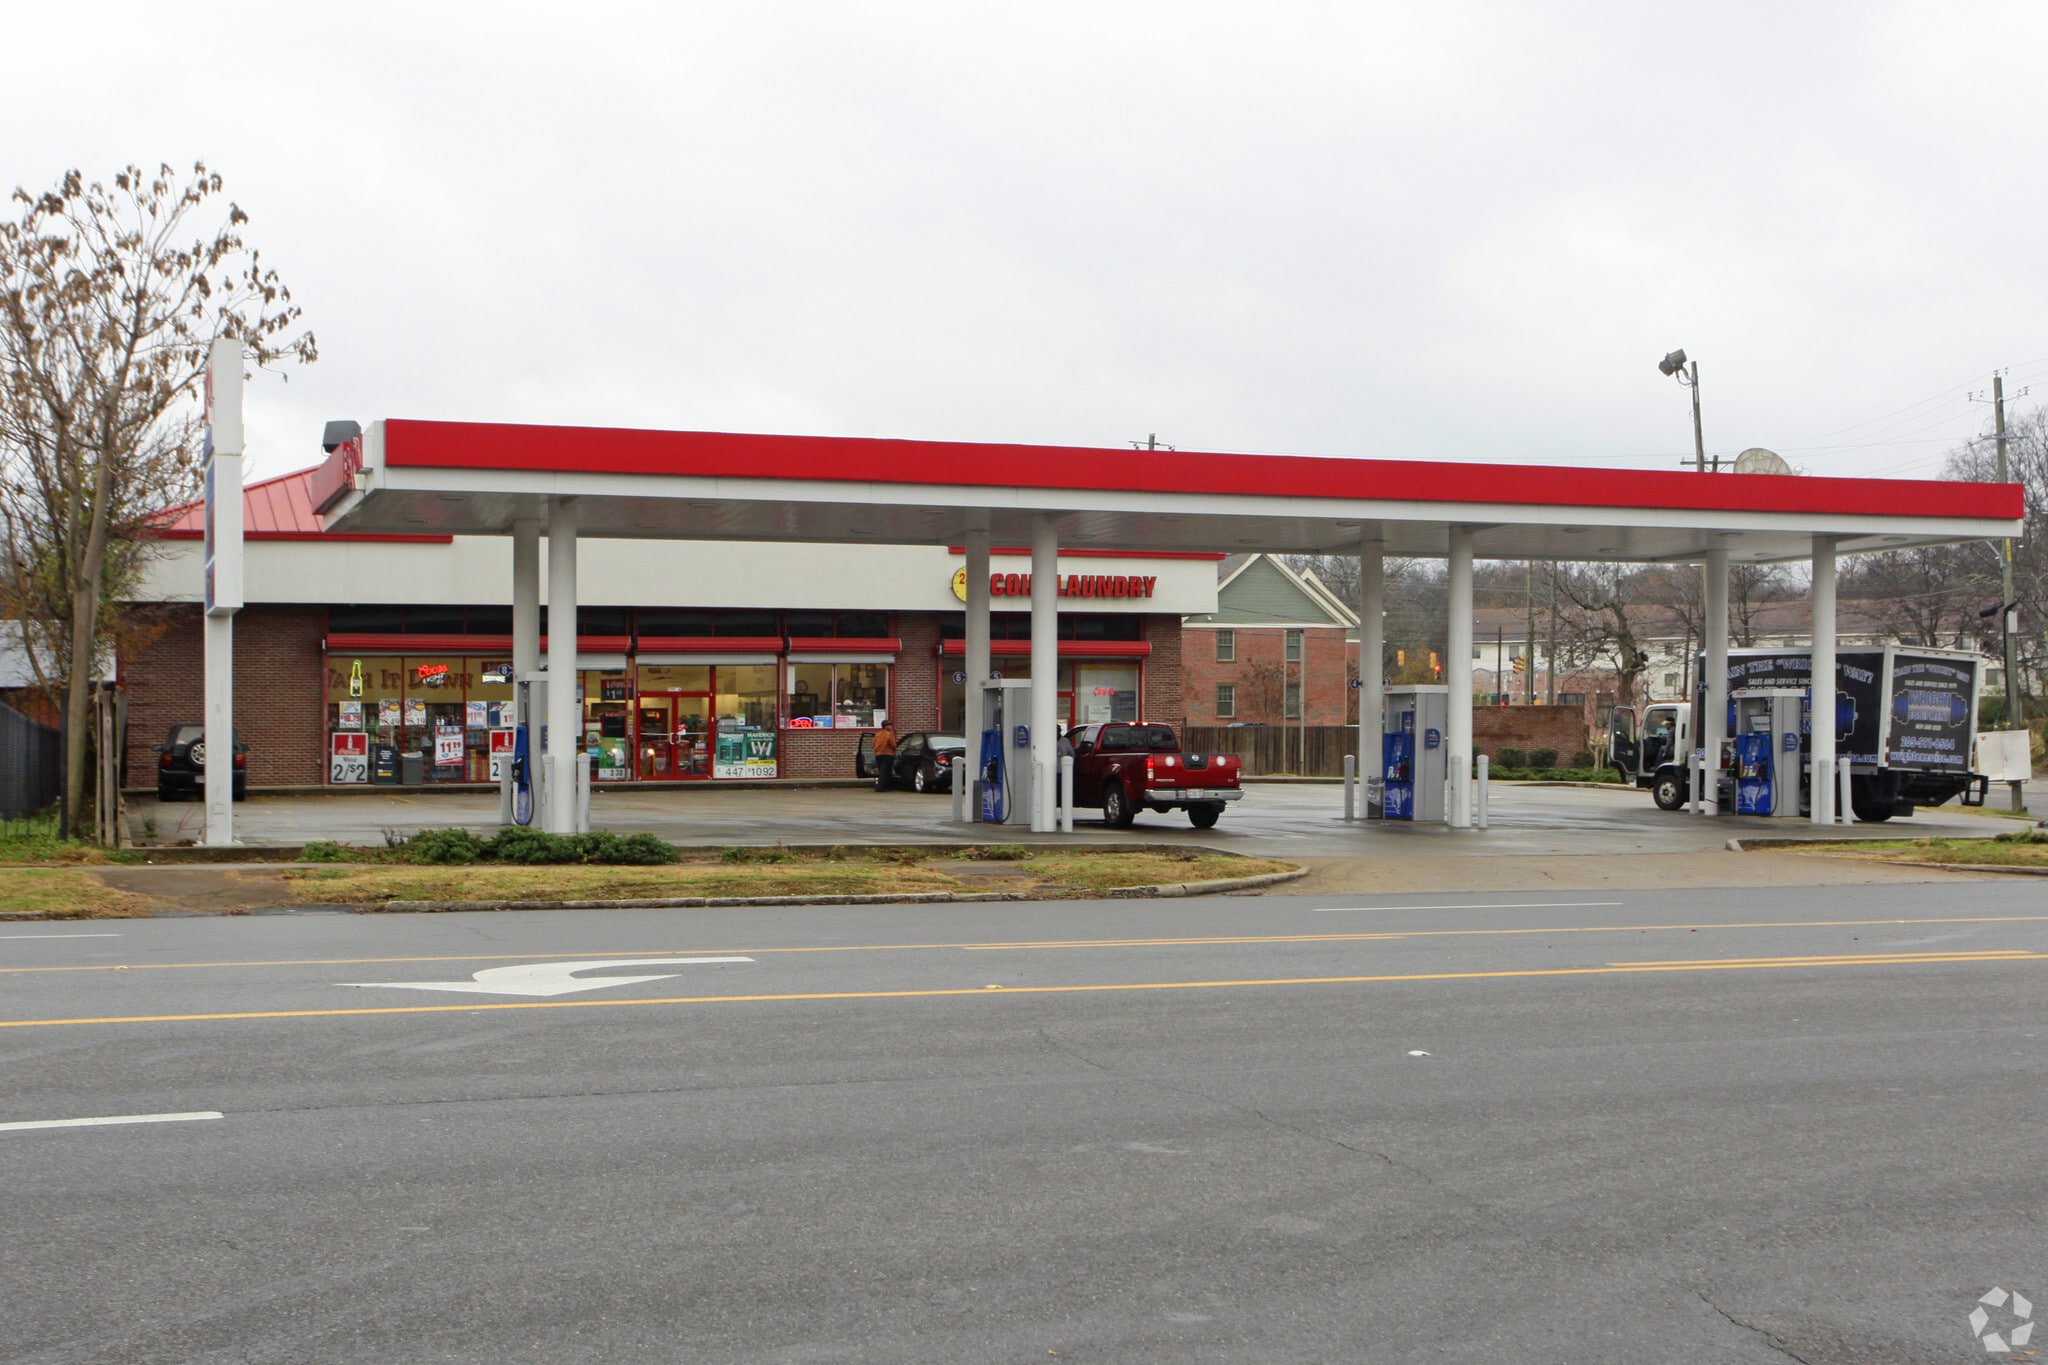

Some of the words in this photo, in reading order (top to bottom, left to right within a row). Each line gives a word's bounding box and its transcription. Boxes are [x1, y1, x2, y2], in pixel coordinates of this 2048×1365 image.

[1057, 574, 1157, 598] LAUNDRY
[1747, 659, 1773, 674] THE
[1748, 678, 1763, 686] SALES
[1764, 678, 1775, 686] AND
[1909, 690, 1951, 707] WRIGHT
[789, 719, 813, 728] OPEN
